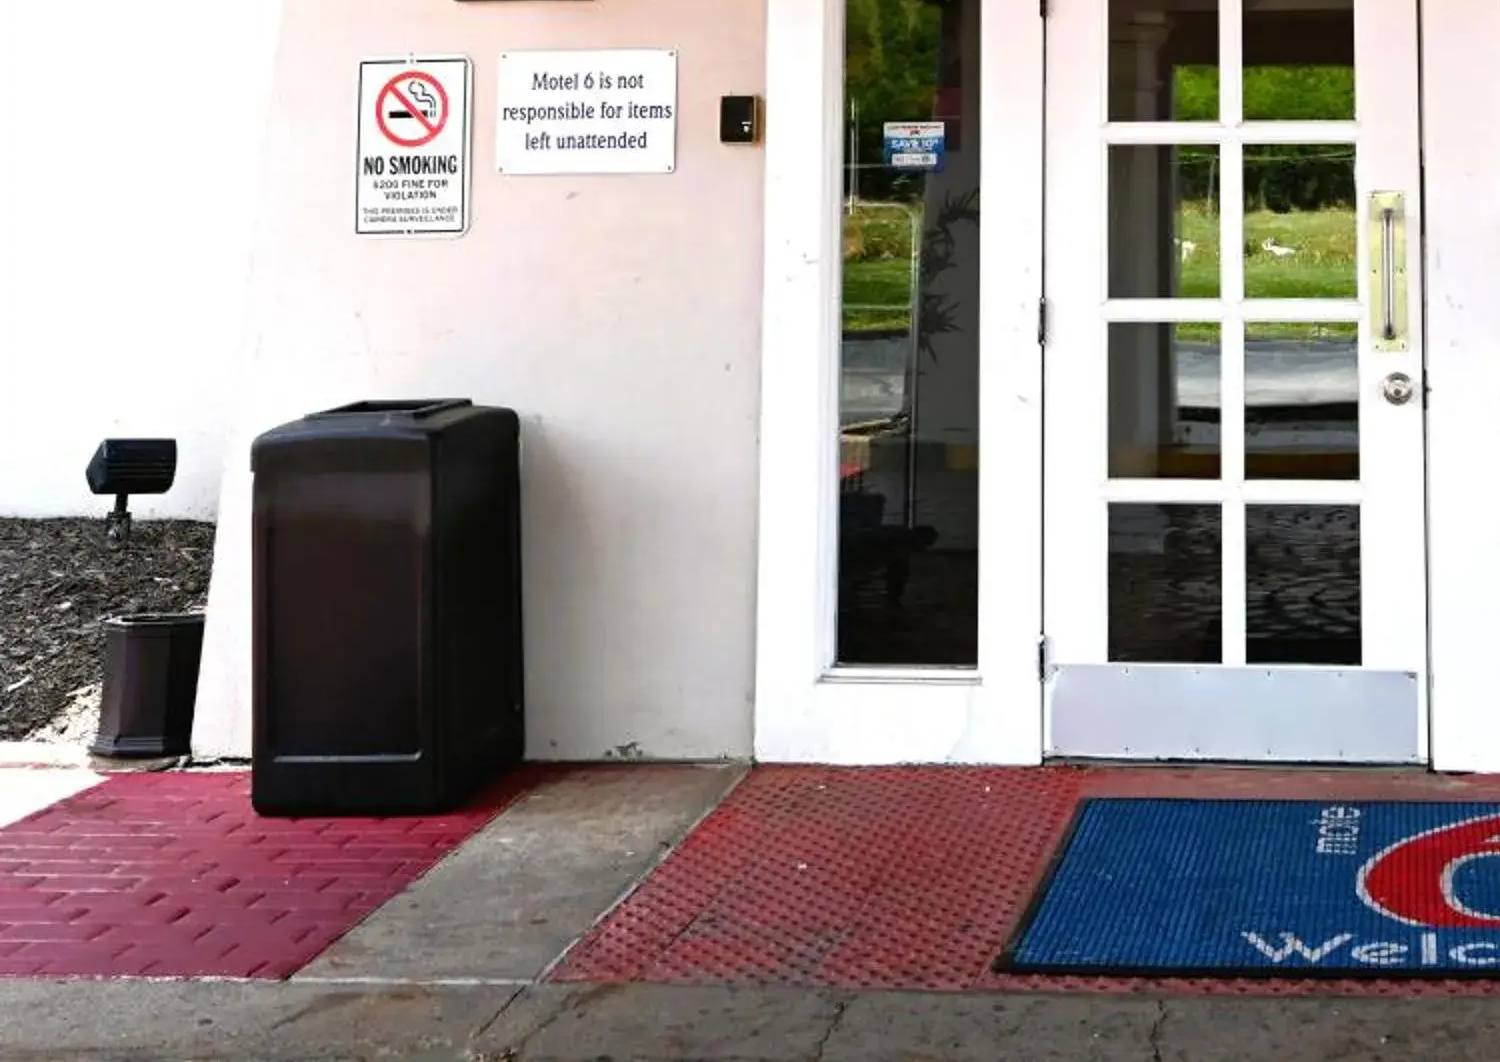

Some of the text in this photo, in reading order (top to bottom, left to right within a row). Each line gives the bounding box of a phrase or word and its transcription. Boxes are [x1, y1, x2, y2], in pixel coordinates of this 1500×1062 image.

[531, 72, 644, 91] Motel 6 is not
[502, 101, 673, 124] responsible for items
[525, 131, 648, 150] left unattended
[363, 155, 458, 175] NO SMOKING
[401, 179, 425, 188] FINE
[428, 179, 449, 188] FOR
[384, 190, 437, 200] VIOLATION
